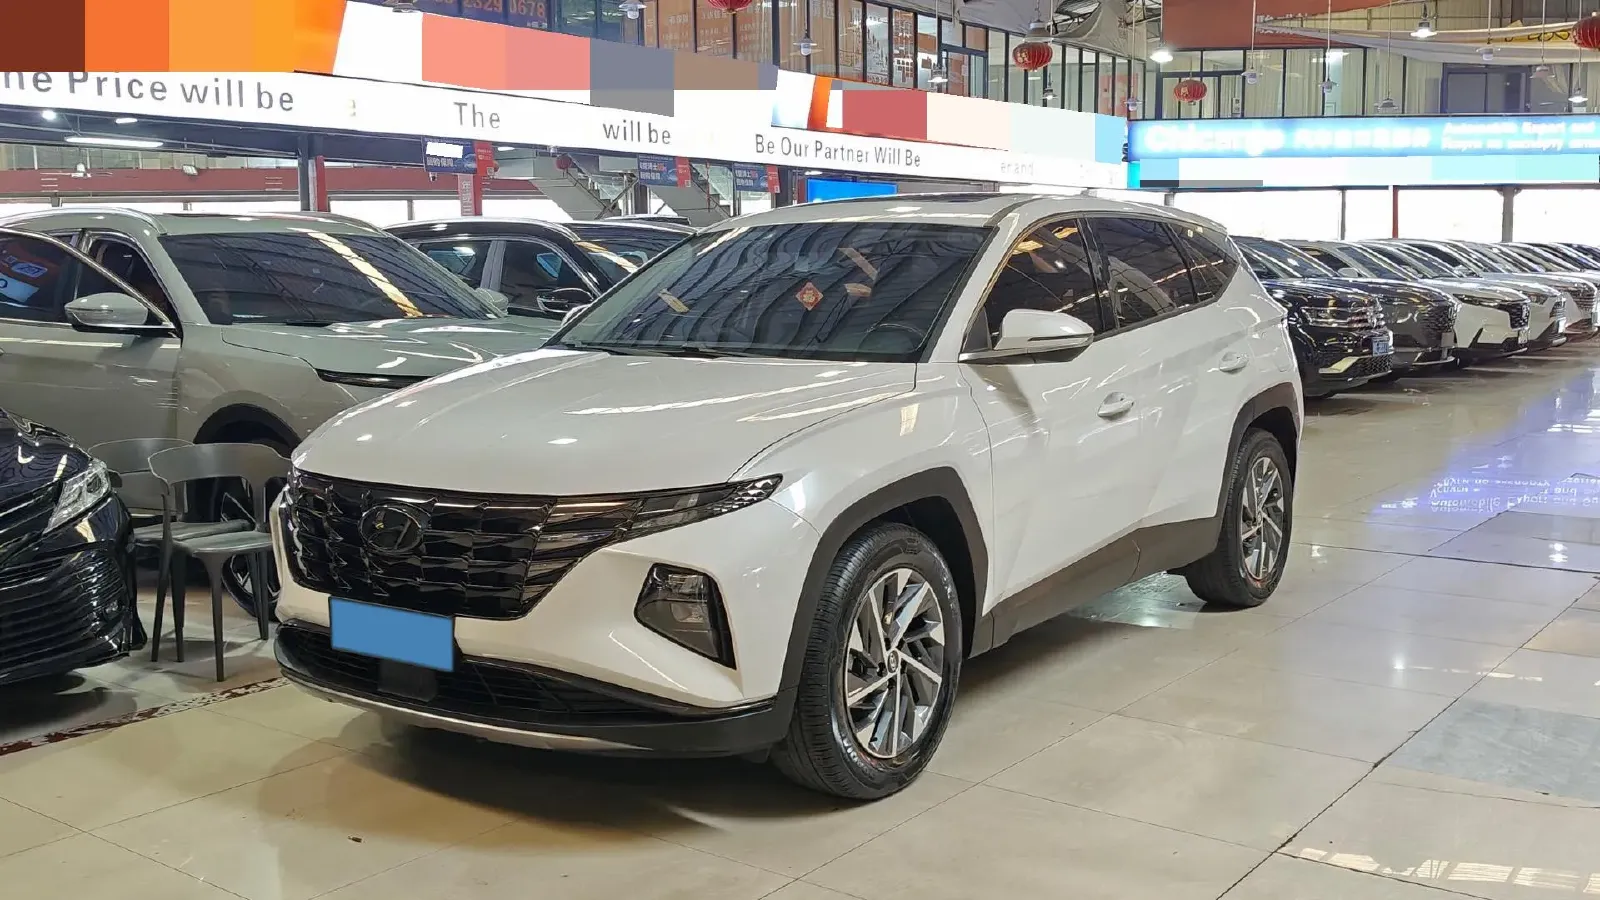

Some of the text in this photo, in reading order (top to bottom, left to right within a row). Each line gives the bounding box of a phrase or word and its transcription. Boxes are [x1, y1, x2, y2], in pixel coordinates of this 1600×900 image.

[69, 72, 167, 102] Price
[180, 78, 244, 108] will
[256, 82, 294, 112] be
[453, 101, 501, 129] The
[602, 120, 671, 145] will be
[755, 134, 775, 154] Be
[781, 137, 809, 158] Our
[814, 138, 870, 164] Partner
[874, 147, 901, 166] Will
[905, 149, 921, 167] Be
